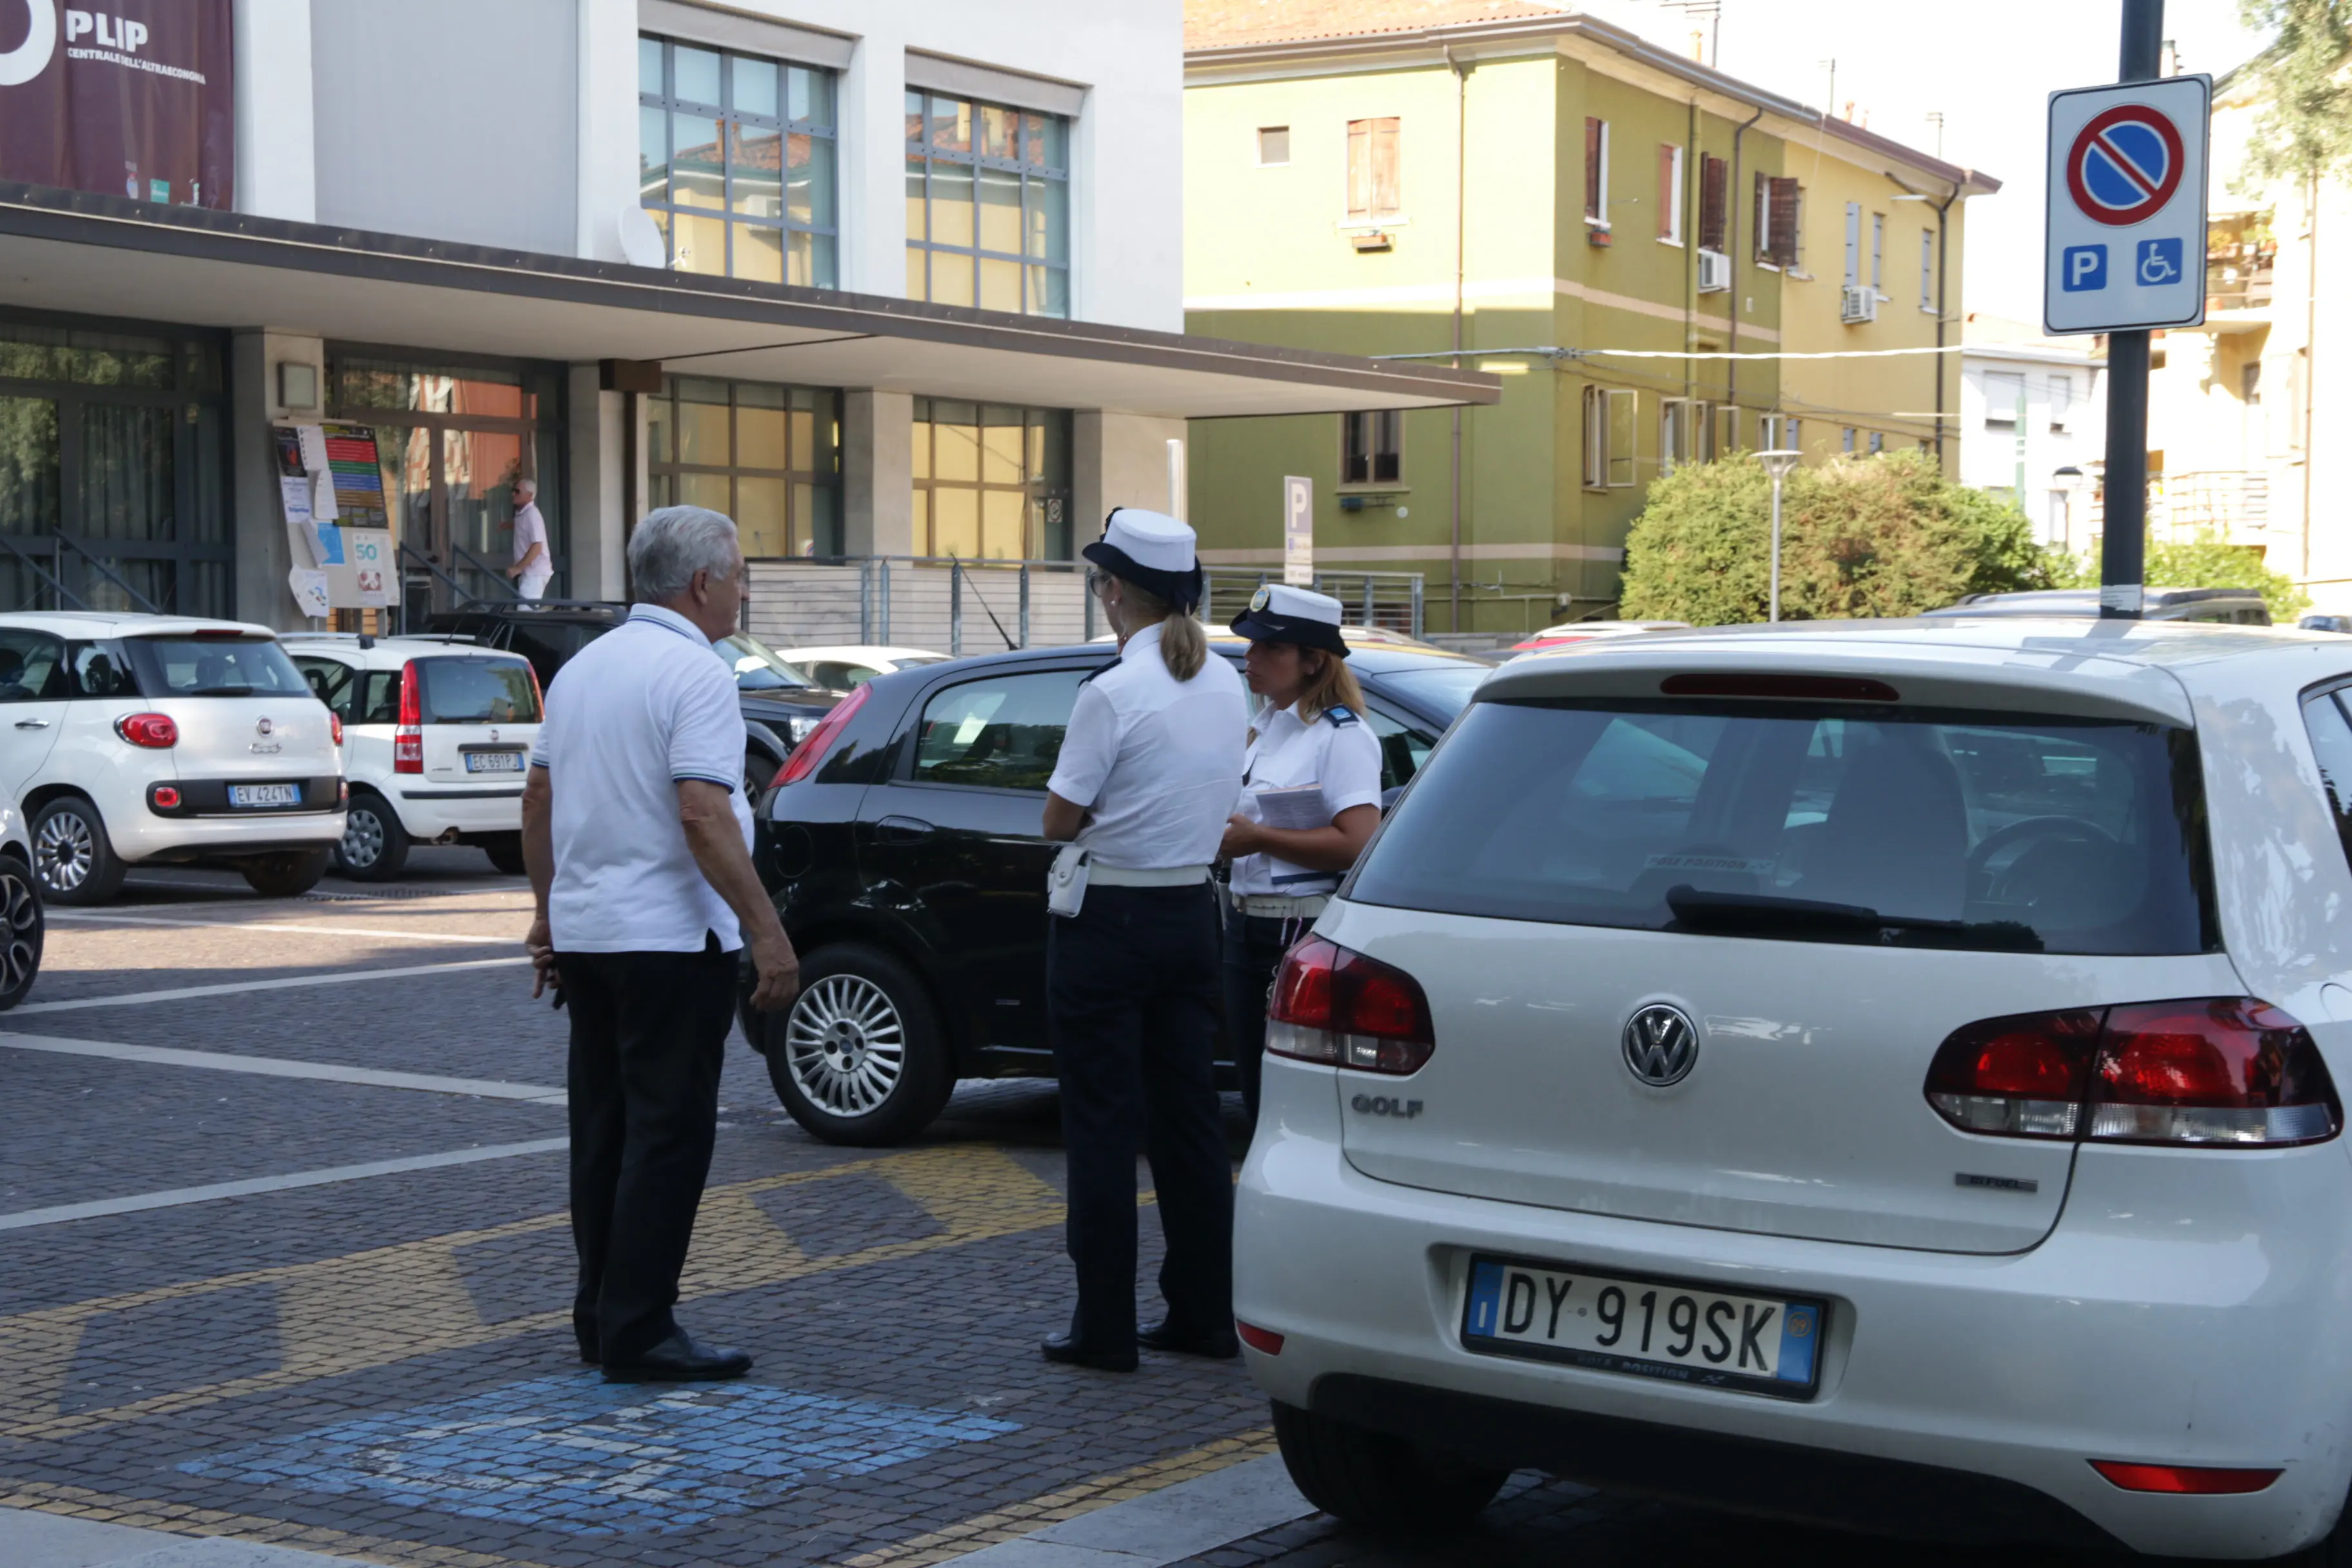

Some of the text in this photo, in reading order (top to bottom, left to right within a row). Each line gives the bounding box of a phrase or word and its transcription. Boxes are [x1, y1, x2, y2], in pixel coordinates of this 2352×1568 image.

[66, 10, 148, 52] PLIP
[2072, 251, 2099, 286] P
[1291, 483, 1307, 528] P
[1351, 1093, 1424, 1119] GOLF
[1504, 1272, 1777, 1371] DY 919SK
[1622, 1361, 1690, 1380] POSITION
